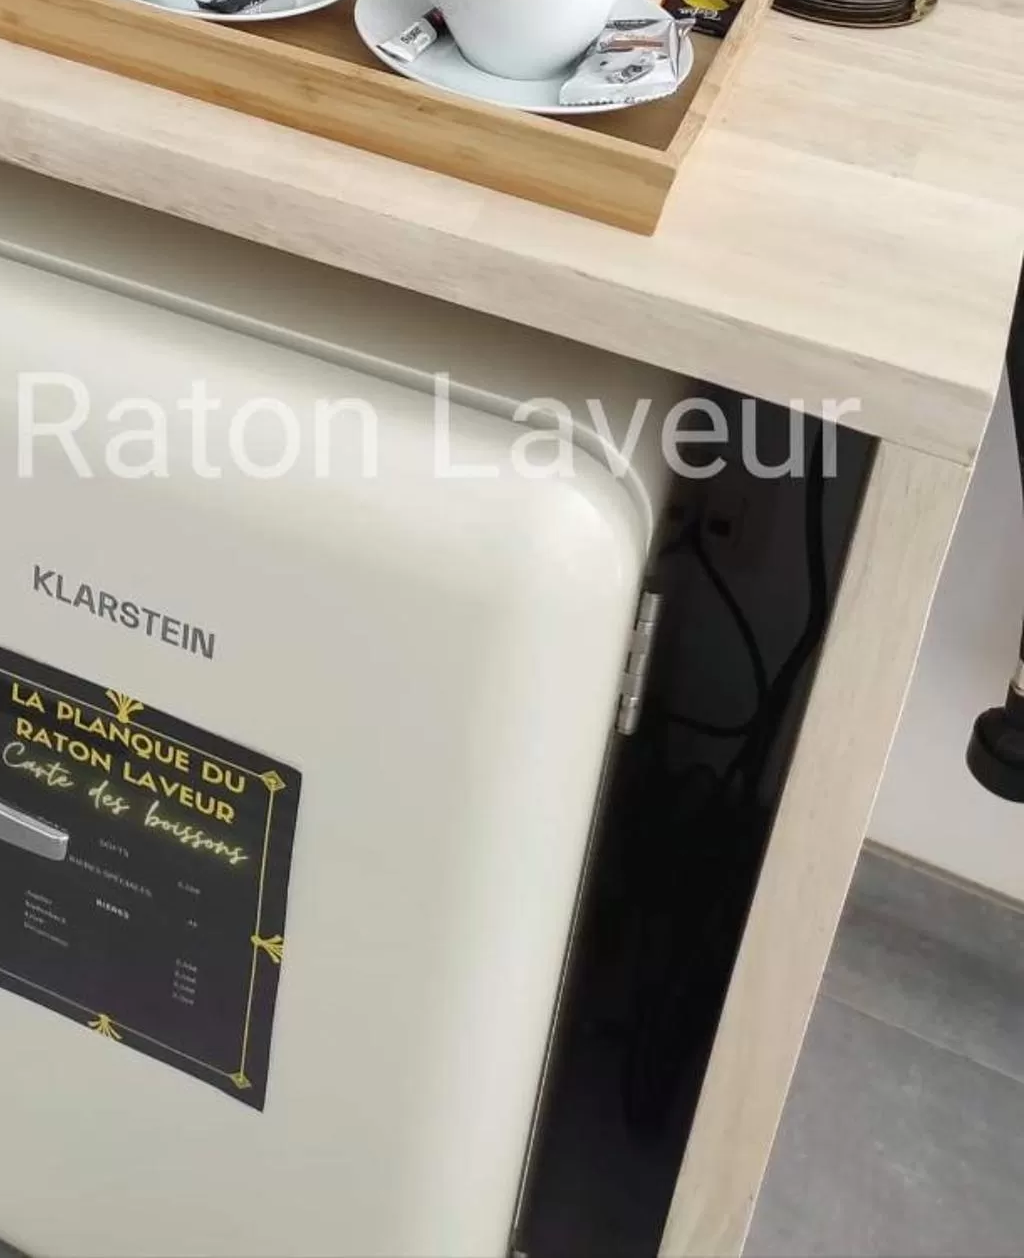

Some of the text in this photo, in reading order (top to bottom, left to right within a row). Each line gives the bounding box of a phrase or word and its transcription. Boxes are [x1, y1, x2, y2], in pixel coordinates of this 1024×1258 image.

[32, 564, 216, 660] KLARSTEIN
[11, 682, 247, 794] LA PLANQUE DU
[16, 717, 236, 825] RATON LAVEUR
[2, 741, 251, 866] Carte des boissons
